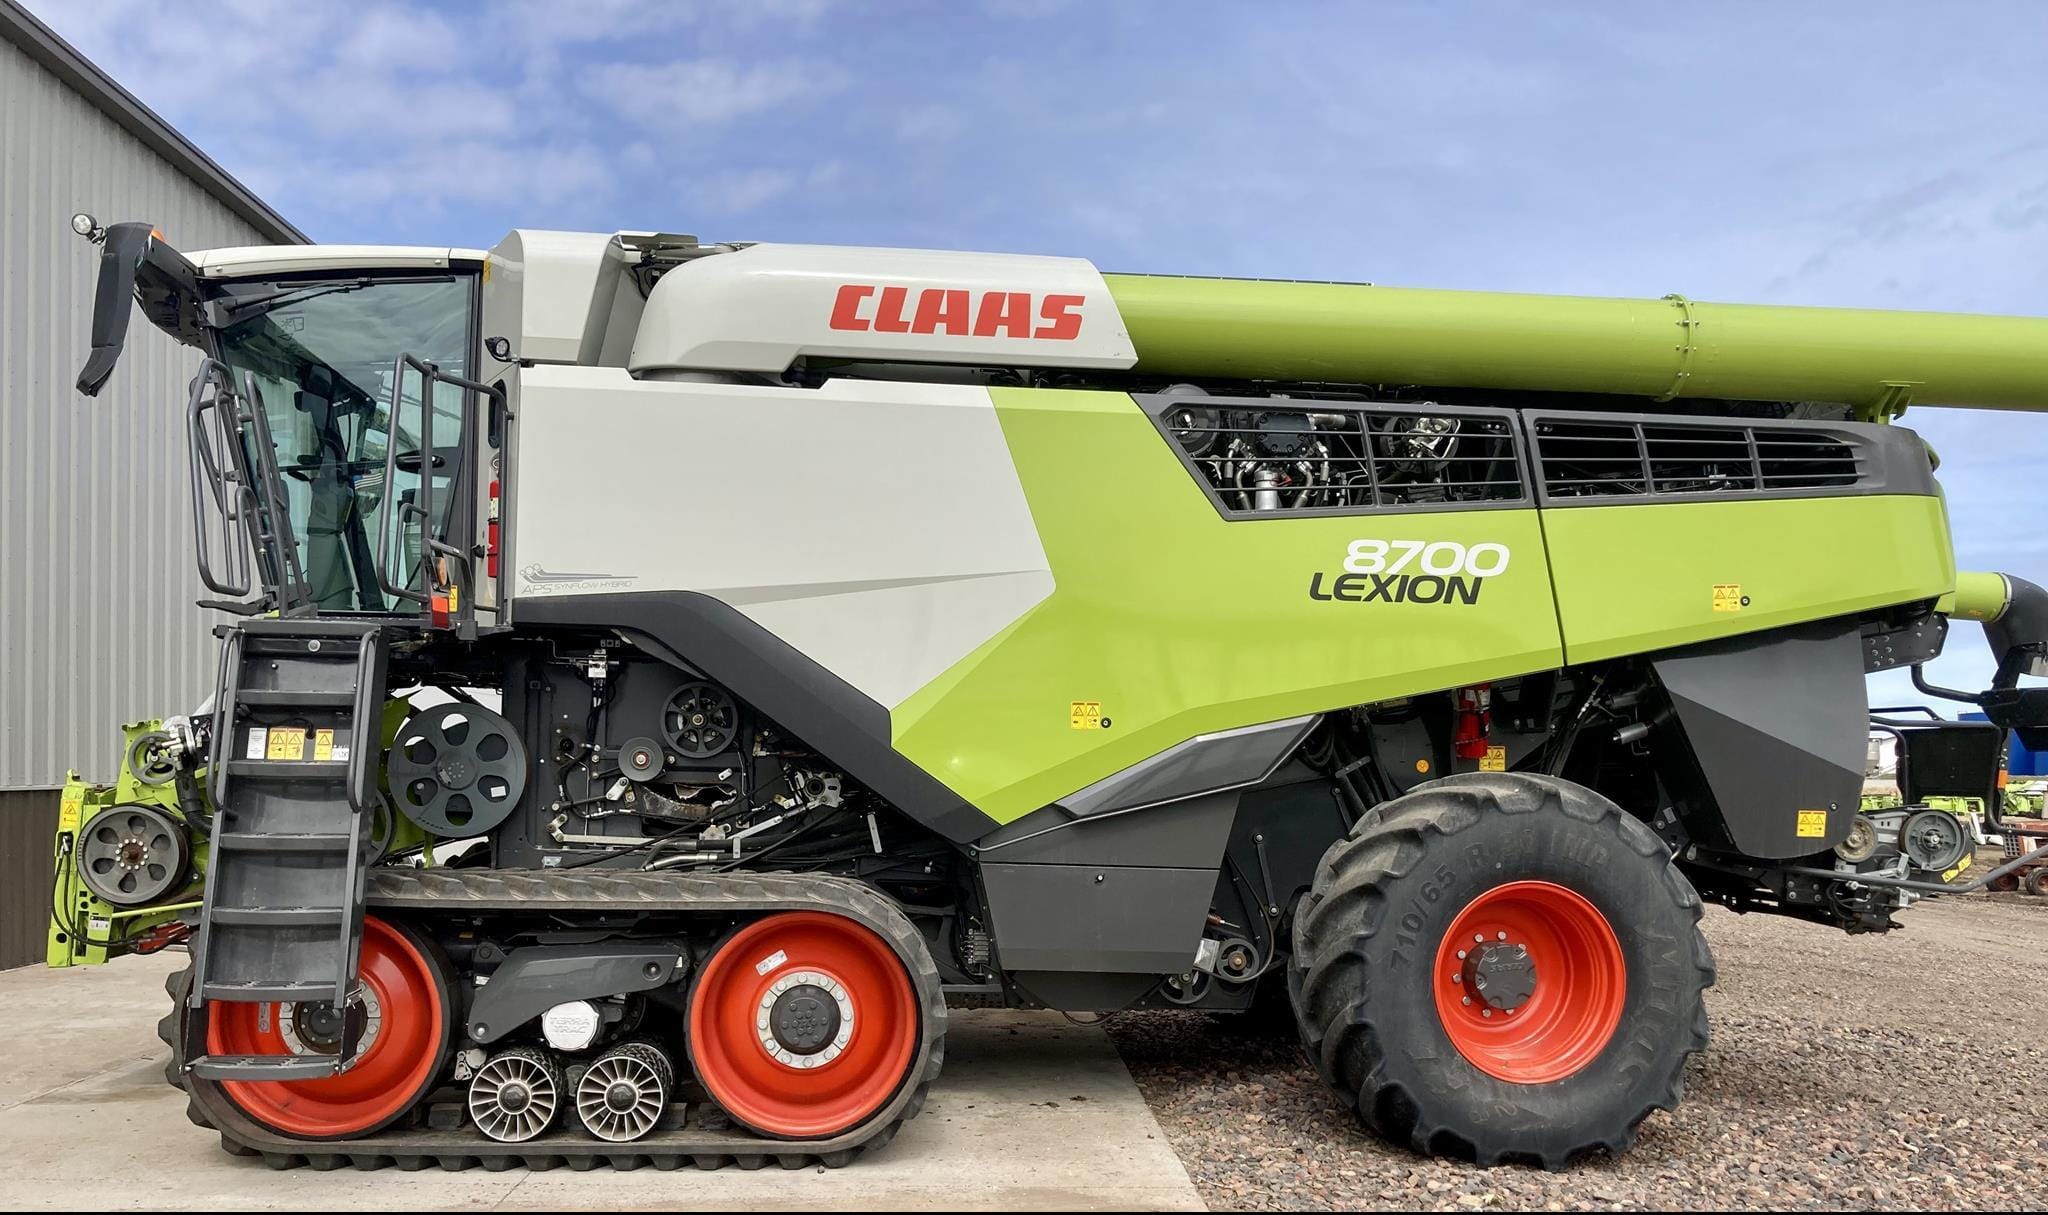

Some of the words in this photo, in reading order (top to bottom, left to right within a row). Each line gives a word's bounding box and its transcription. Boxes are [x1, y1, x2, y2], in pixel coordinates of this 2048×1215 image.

[829, 284, 1086, 340] CLAAS
[1343, 538, 1511, 577] 8700
[521, 584, 553, 595] APS
[554, 582, 598, 590] SYNFLOW
[600, 580, 633, 589] HYBRID
[1309, 571, 1483, 605] LEXION
[1390, 864, 1458, 971] 710/65
